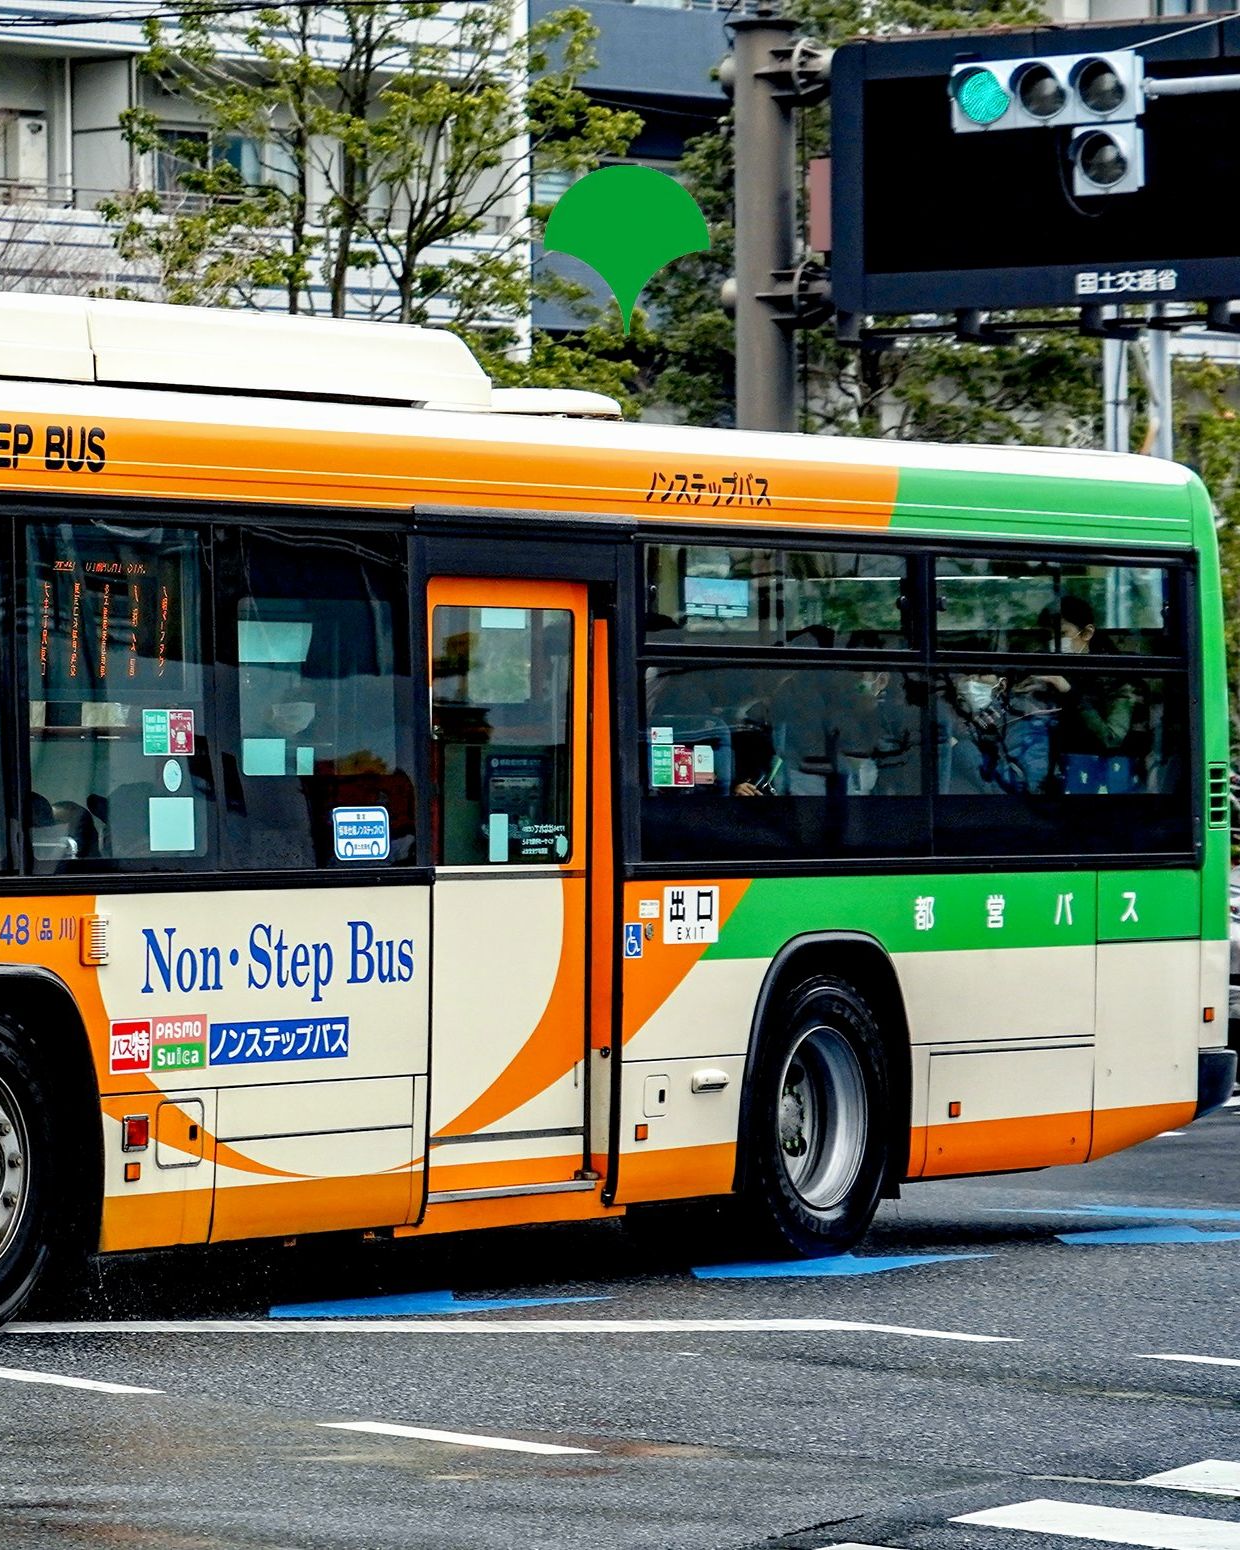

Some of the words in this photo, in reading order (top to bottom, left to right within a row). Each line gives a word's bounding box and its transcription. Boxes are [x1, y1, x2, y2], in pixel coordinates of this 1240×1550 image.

[1076, 268, 1178, 295] 国土交通省
[45, 426, 106, 473] BUS
[646, 471, 772, 507] ノンステップバス
[669, 890, 714, 922] 出口
[677, 926, 707, 941] EXIT
[346, 920, 414, 985] Bus
[155, 1020, 203, 1040] PASMO
[210, 1023, 349, 1059] ノンステップバス
[112, 1030, 151, 1063] バス特
[156, 1044, 200, 1067] Suica
